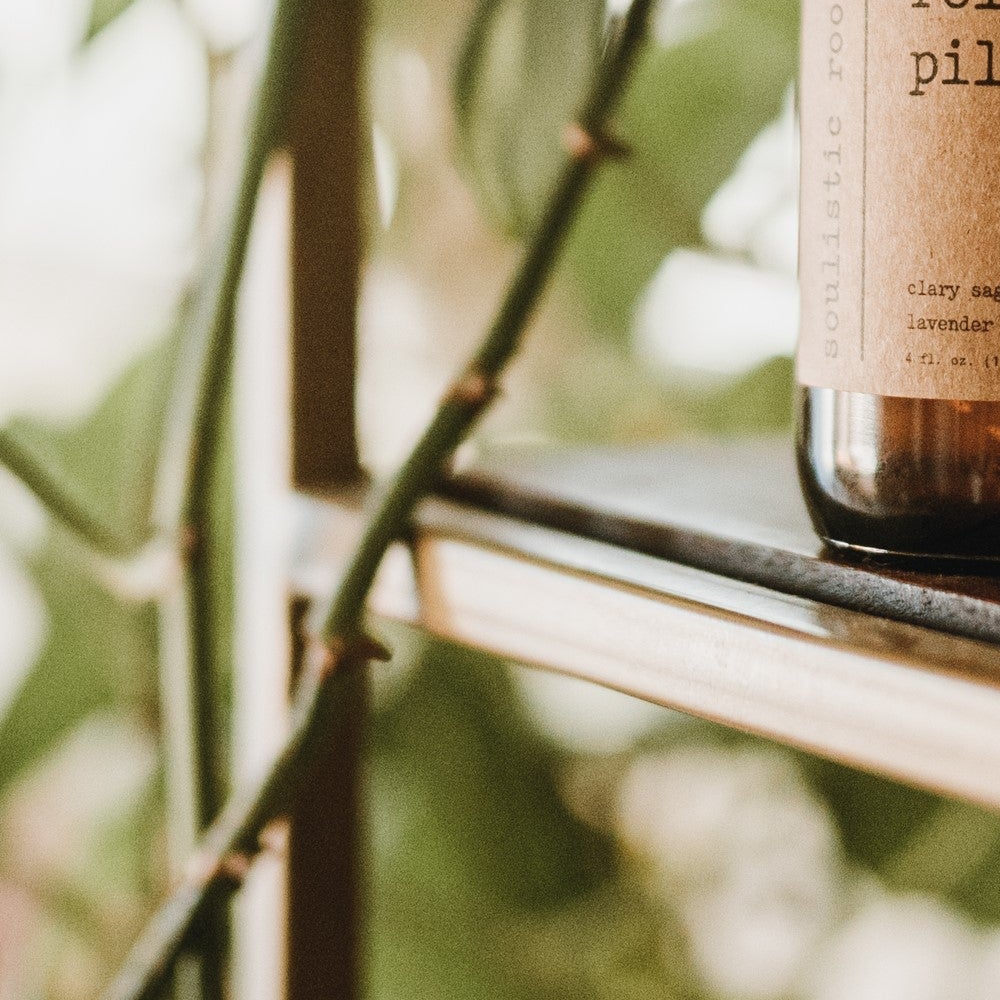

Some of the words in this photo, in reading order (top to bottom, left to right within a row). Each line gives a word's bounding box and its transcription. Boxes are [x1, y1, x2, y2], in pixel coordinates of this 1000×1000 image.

[822, 114, 843, 361] soulistic
[907, 280, 960, 301] clary
[906, 313, 995, 333] lavender
[950, 356, 973, 367] oz.
